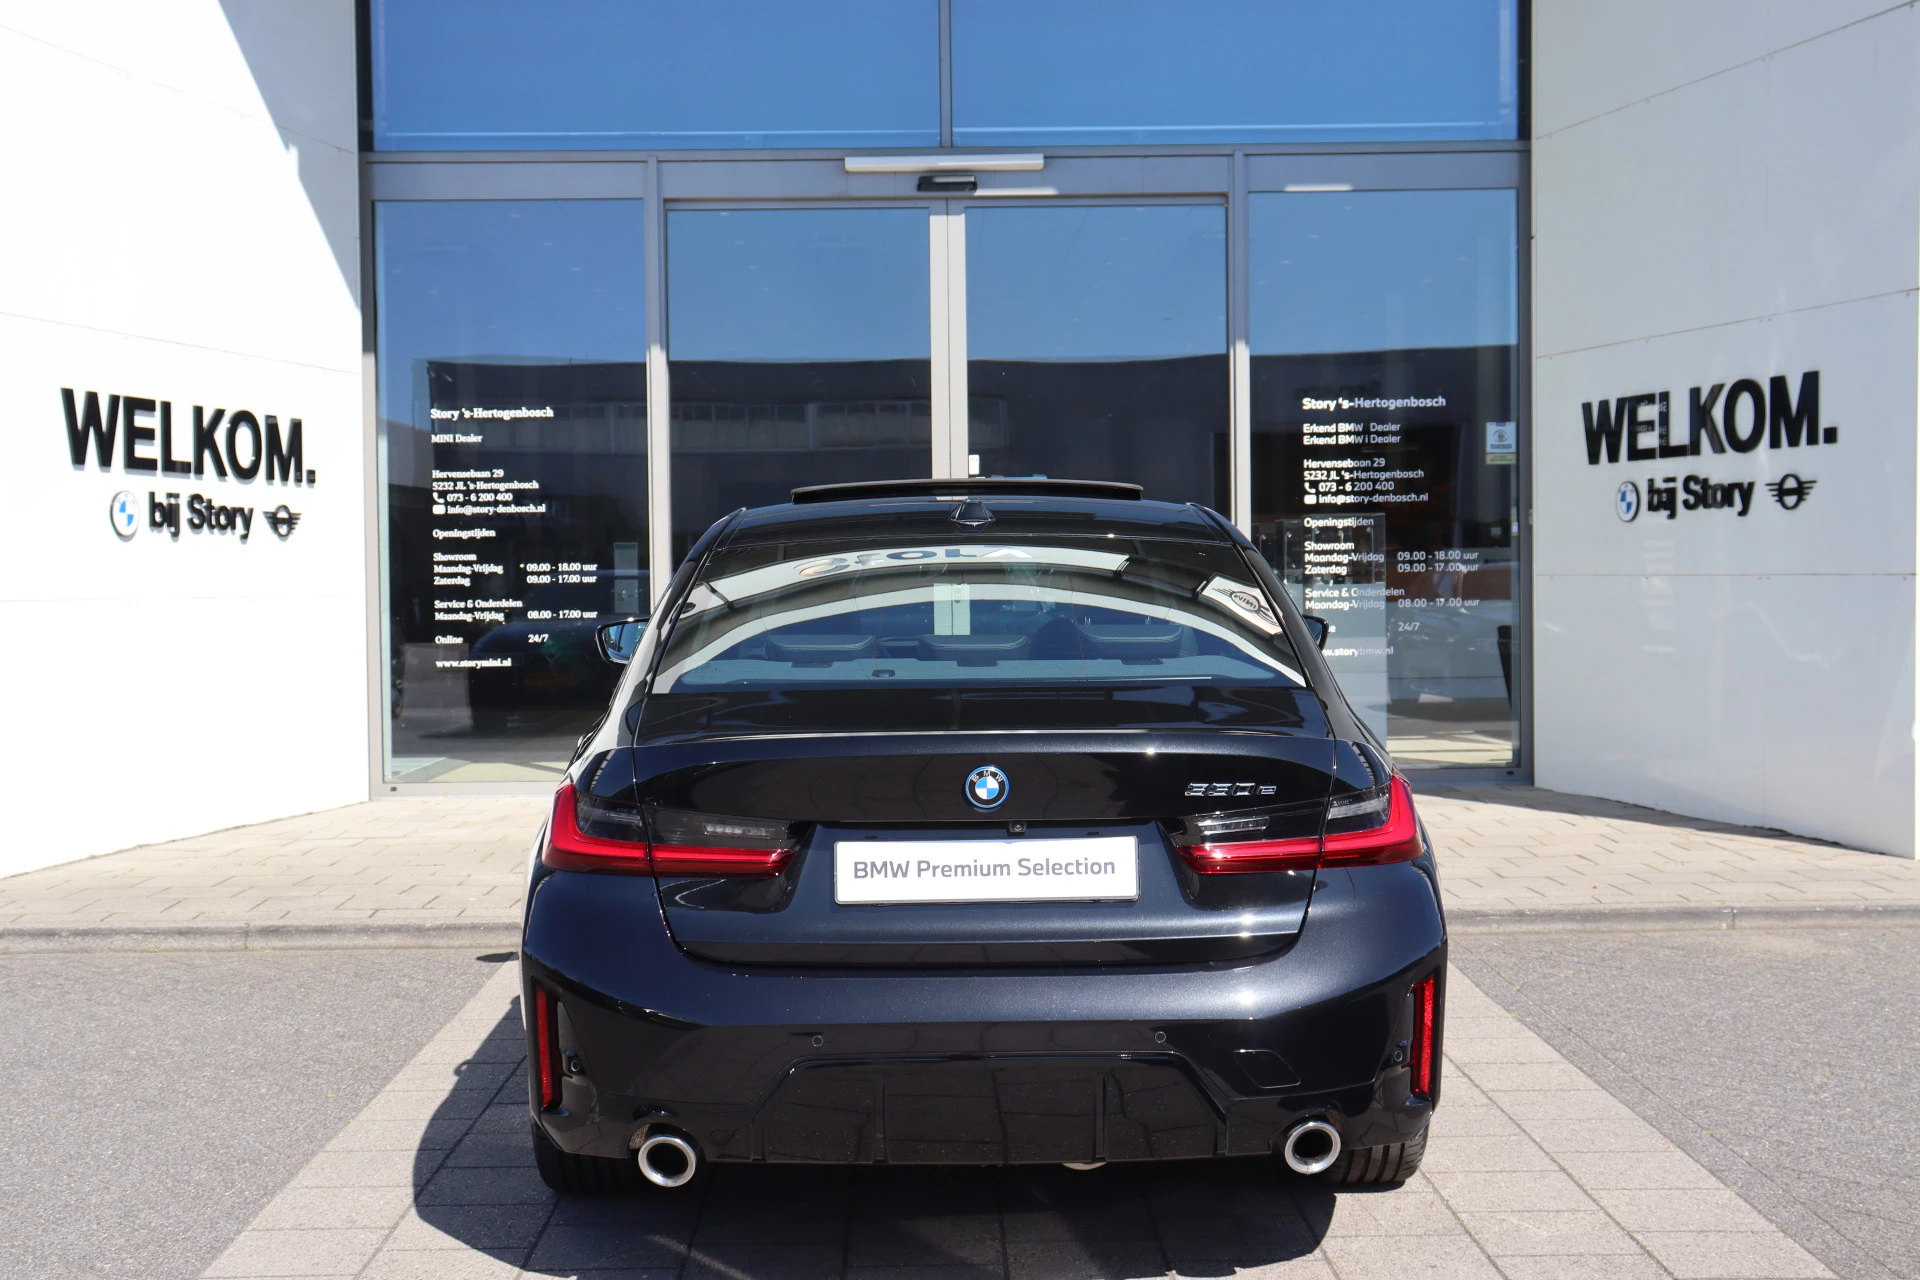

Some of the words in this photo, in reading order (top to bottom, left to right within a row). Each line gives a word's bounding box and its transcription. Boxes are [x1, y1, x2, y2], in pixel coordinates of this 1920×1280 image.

[1302, 398, 1337, 411] Story
[430, 408, 459, 421] Story
[1581, 369, 1837, 465] WELKOM.
[1303, 423, 1336, 433] Erkend
[1338, 423, 1363, 433] BMW
[1370, 423, 1400, 432] Dealer
[60, 387, 316, 484] WELKOM.
[431, 434, 453, 443] MINI
[455, 434, 483, 443] Dealer
[1303, 435, 1336, 445] Erkend
[1338, 435, 1363, 445] BMW
[1370, 435, 1401, 443] Dealer
[1304, 459, 1371, 468] Hervensebaan
[1373, 458, 1385, 467] 29
[432, 470, 491, 479] Hervensebaan
[492, 469, 504, 478] 29
[1304, 471, 1327, 480] 5232
[1329, 471, 1340, 480] JL
[432, 482, 454, 491] 5232
[455, 482, 466, 490] JL
[1319, 483, 1337, 491] 073
[1345, 482, 1352, 491] 6
[1353, 482, 1373, 490] 200
[1375, 482, 1394, 490] 400
[447, 493, 464, 501] 073
[470, 493, 477, 501] 6
[477, 493, 495, 501] 200
[496, 492, 513, 501] 400
[1319, 493, 1428, 505] info@story-denbosch.nl
[1682, 475, 1755, 517] Story
[447, 504, 546, 515] info@story-denbosch.nl
[149, 491, 180, 538] bij
[187, 494, 253, 540] Story
[1304, 517, 1374, 529] Openingstijden
[432, 528, 496, 540] Openingstijden
[1304, 541, 1354, 550] Showroom
[433, 553, 477, 561] Showroom
[1304, 552, 1385, 564] Maandag-Vrijdag
[1397, 552, 1425, 560] 09.00
[1435, 551, 1461, 560] 18.00
[434, 564, 503, 574] Maandag-Vrijdag
[526, 563, 550, 572] 09.00
[557, 563, 581, 572] 18.00
[1305, 565, 1347, 575] Zaterdag
[1397, 564, 1425, 573] 09.00
[434, 577, 471, 586] Zaterdag
[526, 575, 550, 584] 09.00
[557, 575, 581, 583] 17.00
[1305, 588, 1340, 598] Service
[1341, 588, 1349, 597] &
[1351, 588, 1404, 597] Onderdelen
[434, 600, 465, 609] Service
[467, 600, 473, 609] &
[475, 599, 522, 608] Onderdelen
[1305, 600, 1385, 610] Maandag-Vrijdag
[1398, 599, 1427, 608] 08.00
[434, 612, 504, 622] Maandag-Vrijdag
[527, 610, 551, 619] 08.00
[558, 610, 581, 619] 17.00
[1398, 622, 1420, 631] 24/7
[435, 635, 463, 644] Online
[528, 634, 549, 643] 24/7
[436, 658, 512, 669] www.storymini.nl
[971, 770, 1004, 782] BMW
[853, 861, 910, 879] BMW
[917, 860, 1011, 878] Premium
[1017, 858, 1116, 876] Selection
